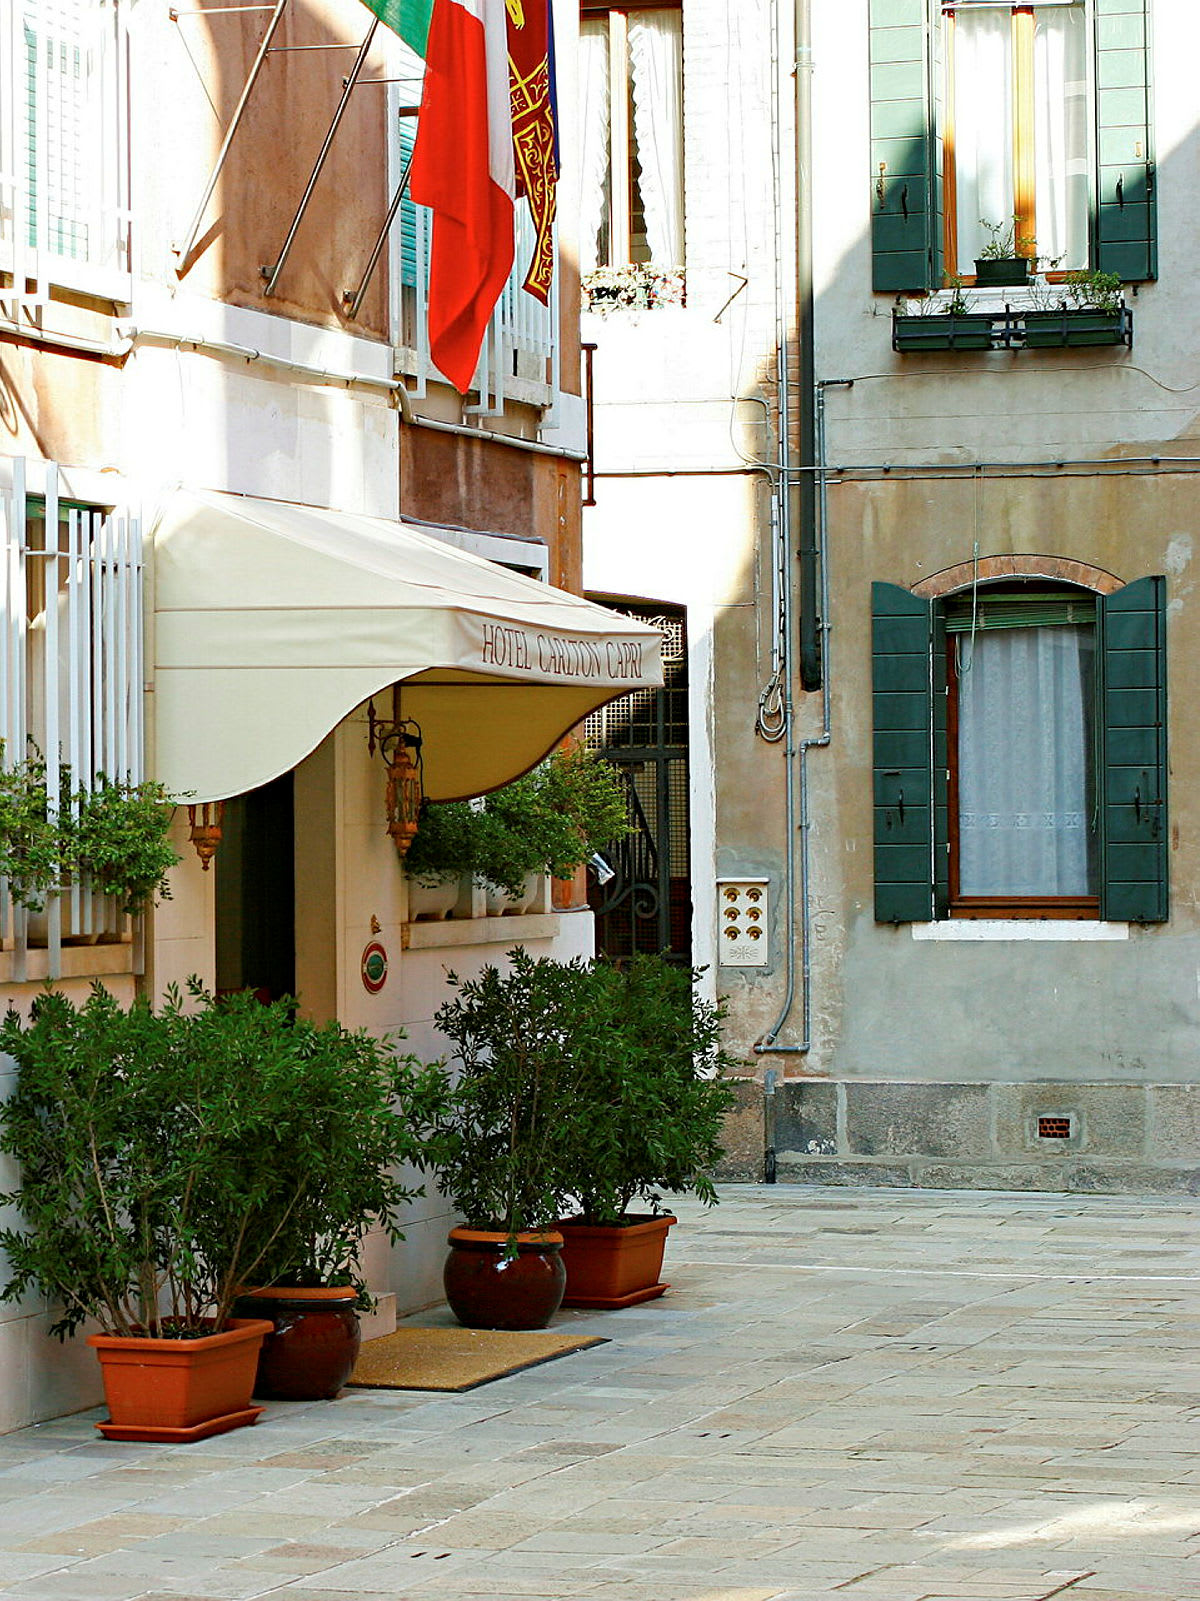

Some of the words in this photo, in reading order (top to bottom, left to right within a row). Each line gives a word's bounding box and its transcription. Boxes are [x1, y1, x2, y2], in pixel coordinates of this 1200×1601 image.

[482, 624, 531, 670] HOTEL
[536, 634, 601, 678] CARLTON
[605, 641, 642, 679] CAPRI
